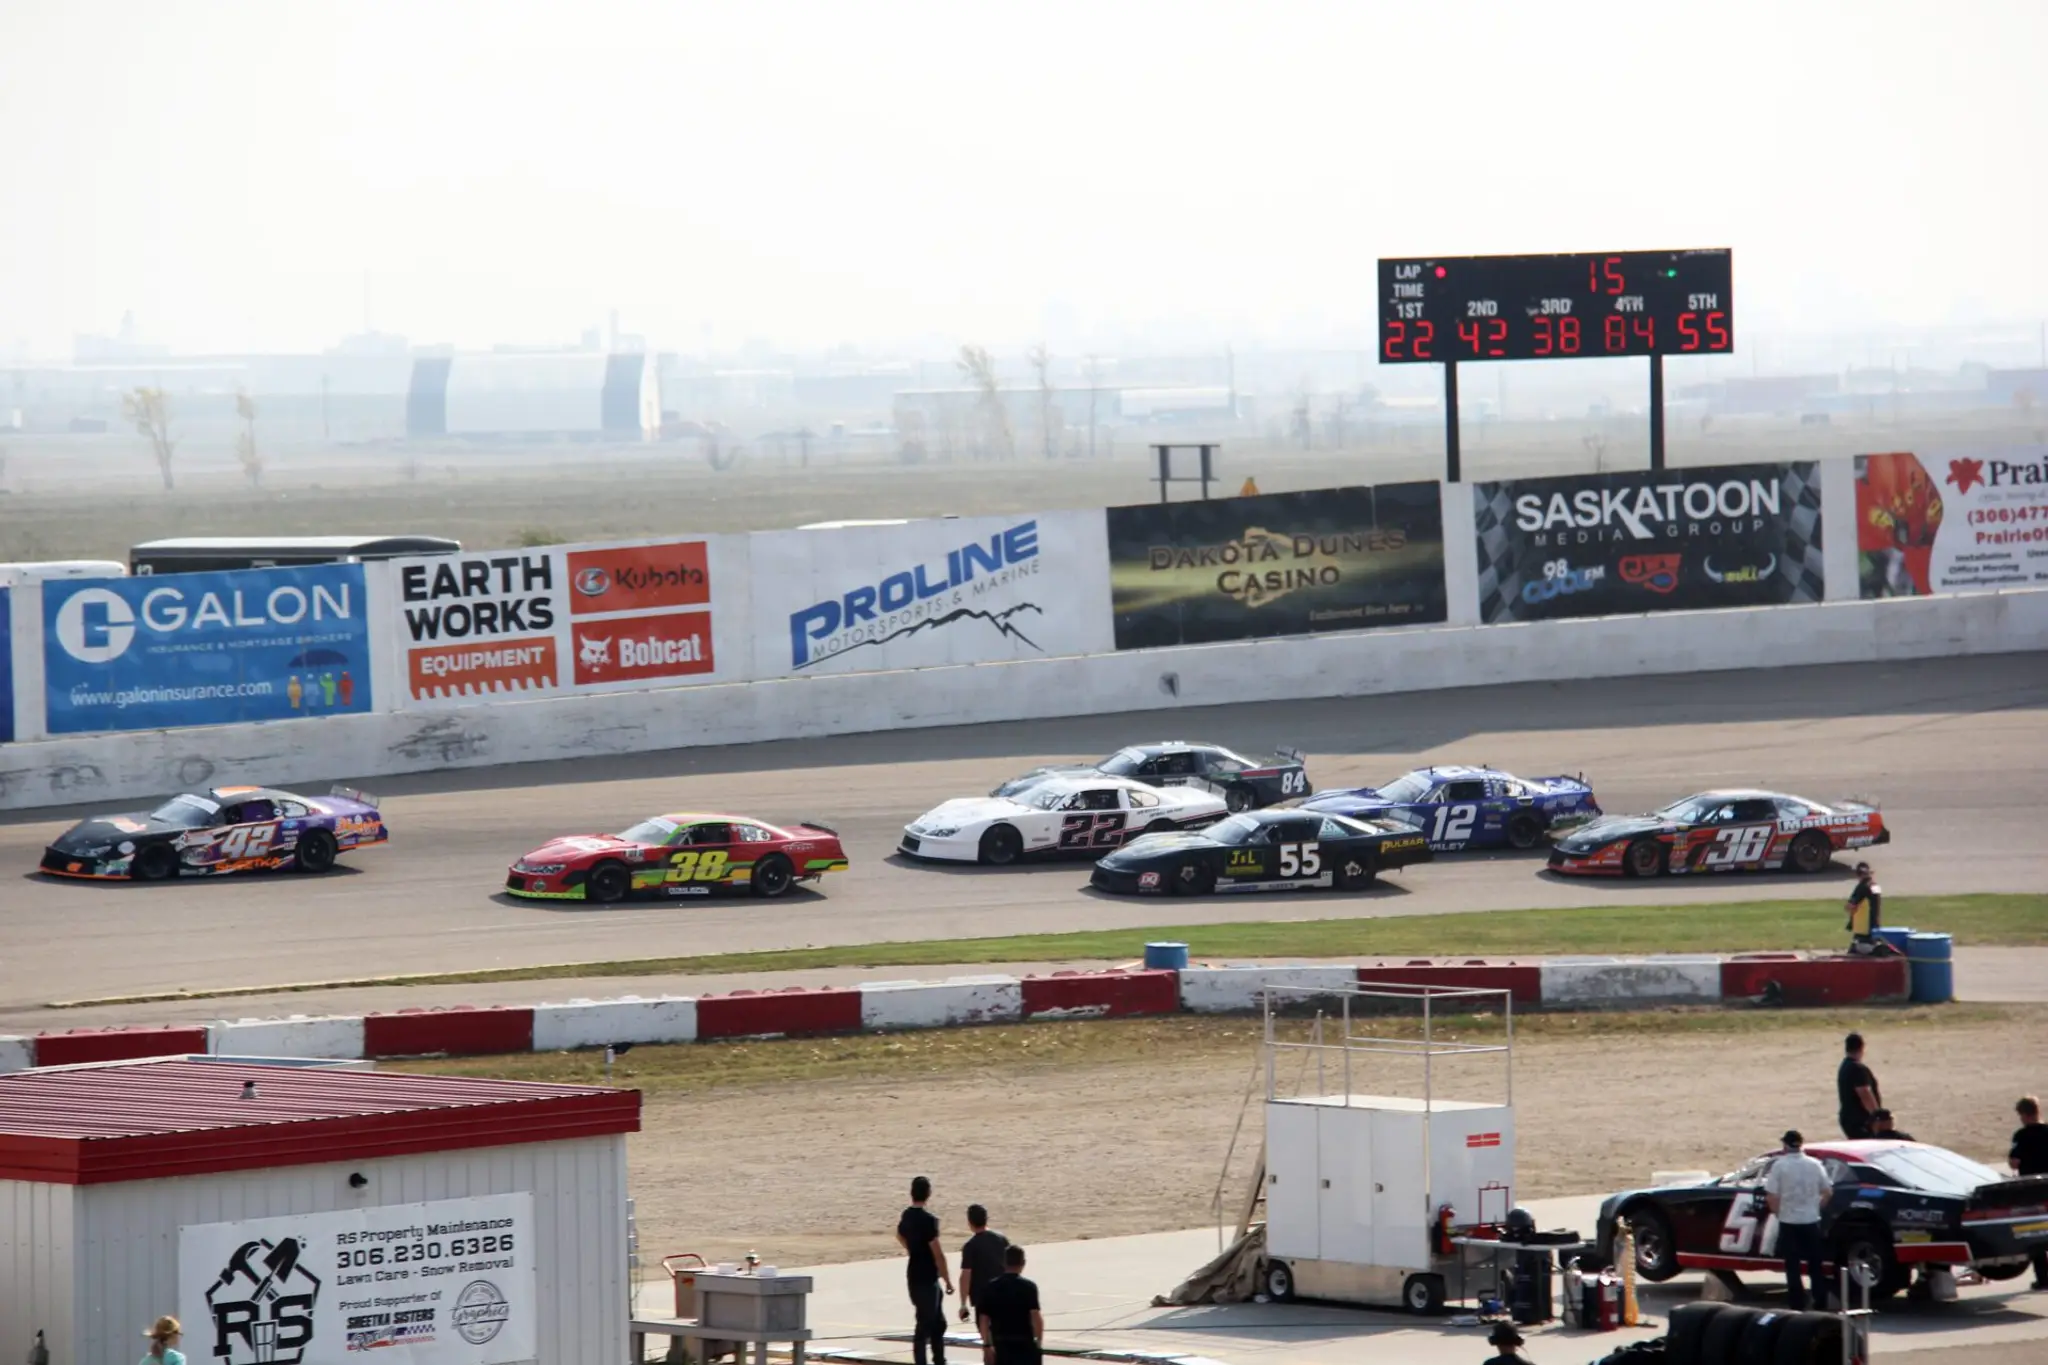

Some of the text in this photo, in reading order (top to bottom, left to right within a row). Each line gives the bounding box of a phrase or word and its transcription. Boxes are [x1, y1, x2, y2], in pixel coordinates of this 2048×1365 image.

[1396, 265, 1421, 279] LAP
[1589, 257, 1625, 295] 15
[1393, 284, 1424, 298] TIME
[1397, 294, 1717, 319] 1ST 2ND 3RD 4TH 5TH
[1385, 312, 1728, 358] 22 42 38 84 55
[1516, 479, 1779, 538] SASKATOON
[1150, 529, 1406, 572] DAKOTA DUNES
[1535, 520, 1763, 546] MEDIA GROUP
[402, 554, 552, 602] EARTH
[615, 563, 704, 590] Kubota
[1217, 566, 1340, 595] CASINO
[1543, 559, 1567, 581] 98
[1585, 564, 1605, 581] FM
[141, 583, 350, 632] GALON
[790, 520, 1038, 667] PROLINE
[813, 559, 1040, 659] MOTORSPORTS & MARINE
[405, 597, 555, 641] WORKS
[420, 647, 545, 677] EQUIPMENT
[619, 633, 702, 668] Bobcat
[70, 680, 272, 708] www.galoninsurance.com
[1282, 771, 1304, 795] 84
[1058, 811, 1127, 850] 22
[1432, 804, 1477, 841] 12
[221, 824, 276, 859] 42
[1706, 826, 1772, 865] 36
[667, 850, 729, 883] 38
[1279, 842, 1321, 877] 55
[337, 1217, 514, 1245] RS Property Maintenance
[337, 1234, 514, 1269] 306.230.6326
[337, 1272, 372, 1286] Lawn
[375, 1268, 409, 1282] Care
[420, 1265, 455, 1277] Snow
[459, 1255, 514, 1273] Removal
[339, 1298, 372, 1311] Proud
[374, 1294, 428, 1308] Supporter
[394, 1308, 435, 1324] SISTERS
[213, 1294, 314, 1357] RS
